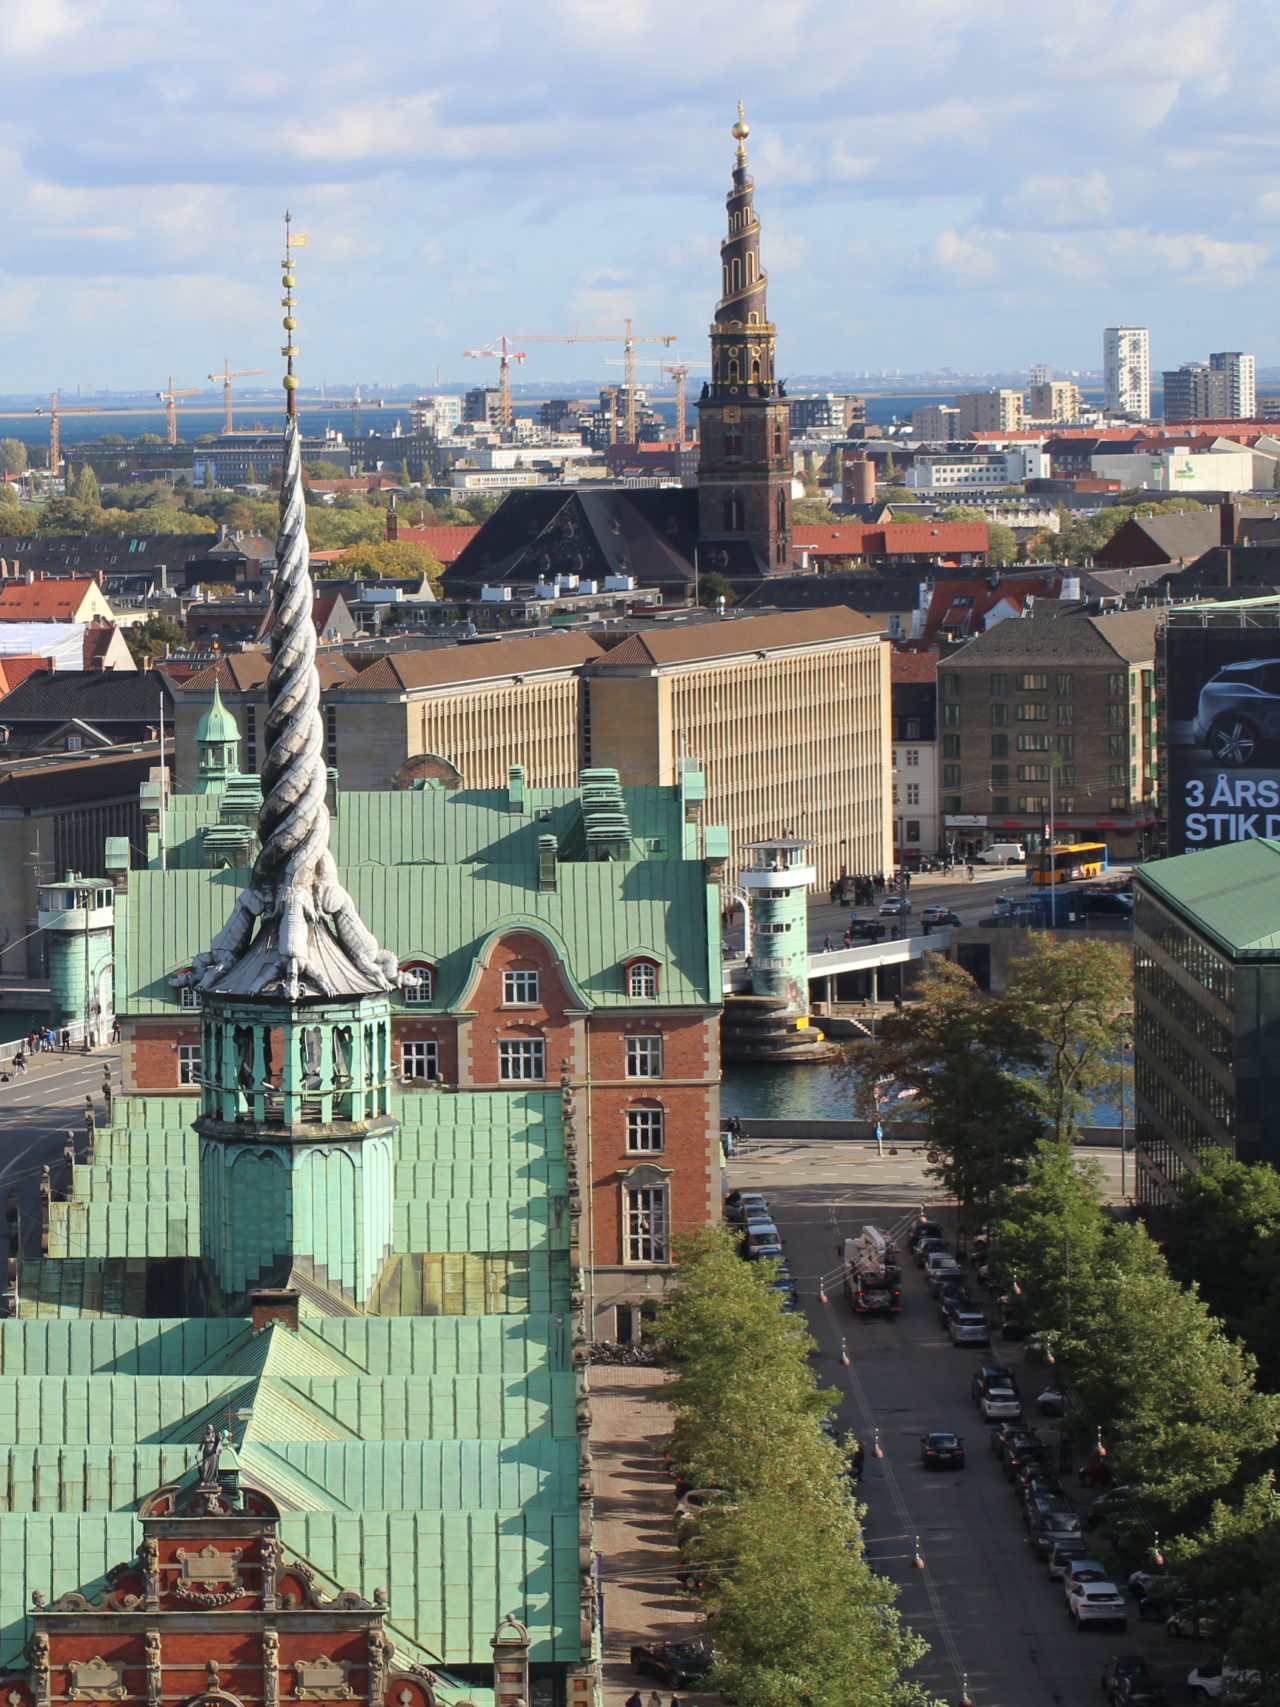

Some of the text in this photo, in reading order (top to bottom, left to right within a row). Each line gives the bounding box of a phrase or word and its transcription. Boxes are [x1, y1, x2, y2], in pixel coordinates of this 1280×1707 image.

[1185, 773, 1280, 808] 3 ÅRS
[1185, 812, 1260, 841] STIK
